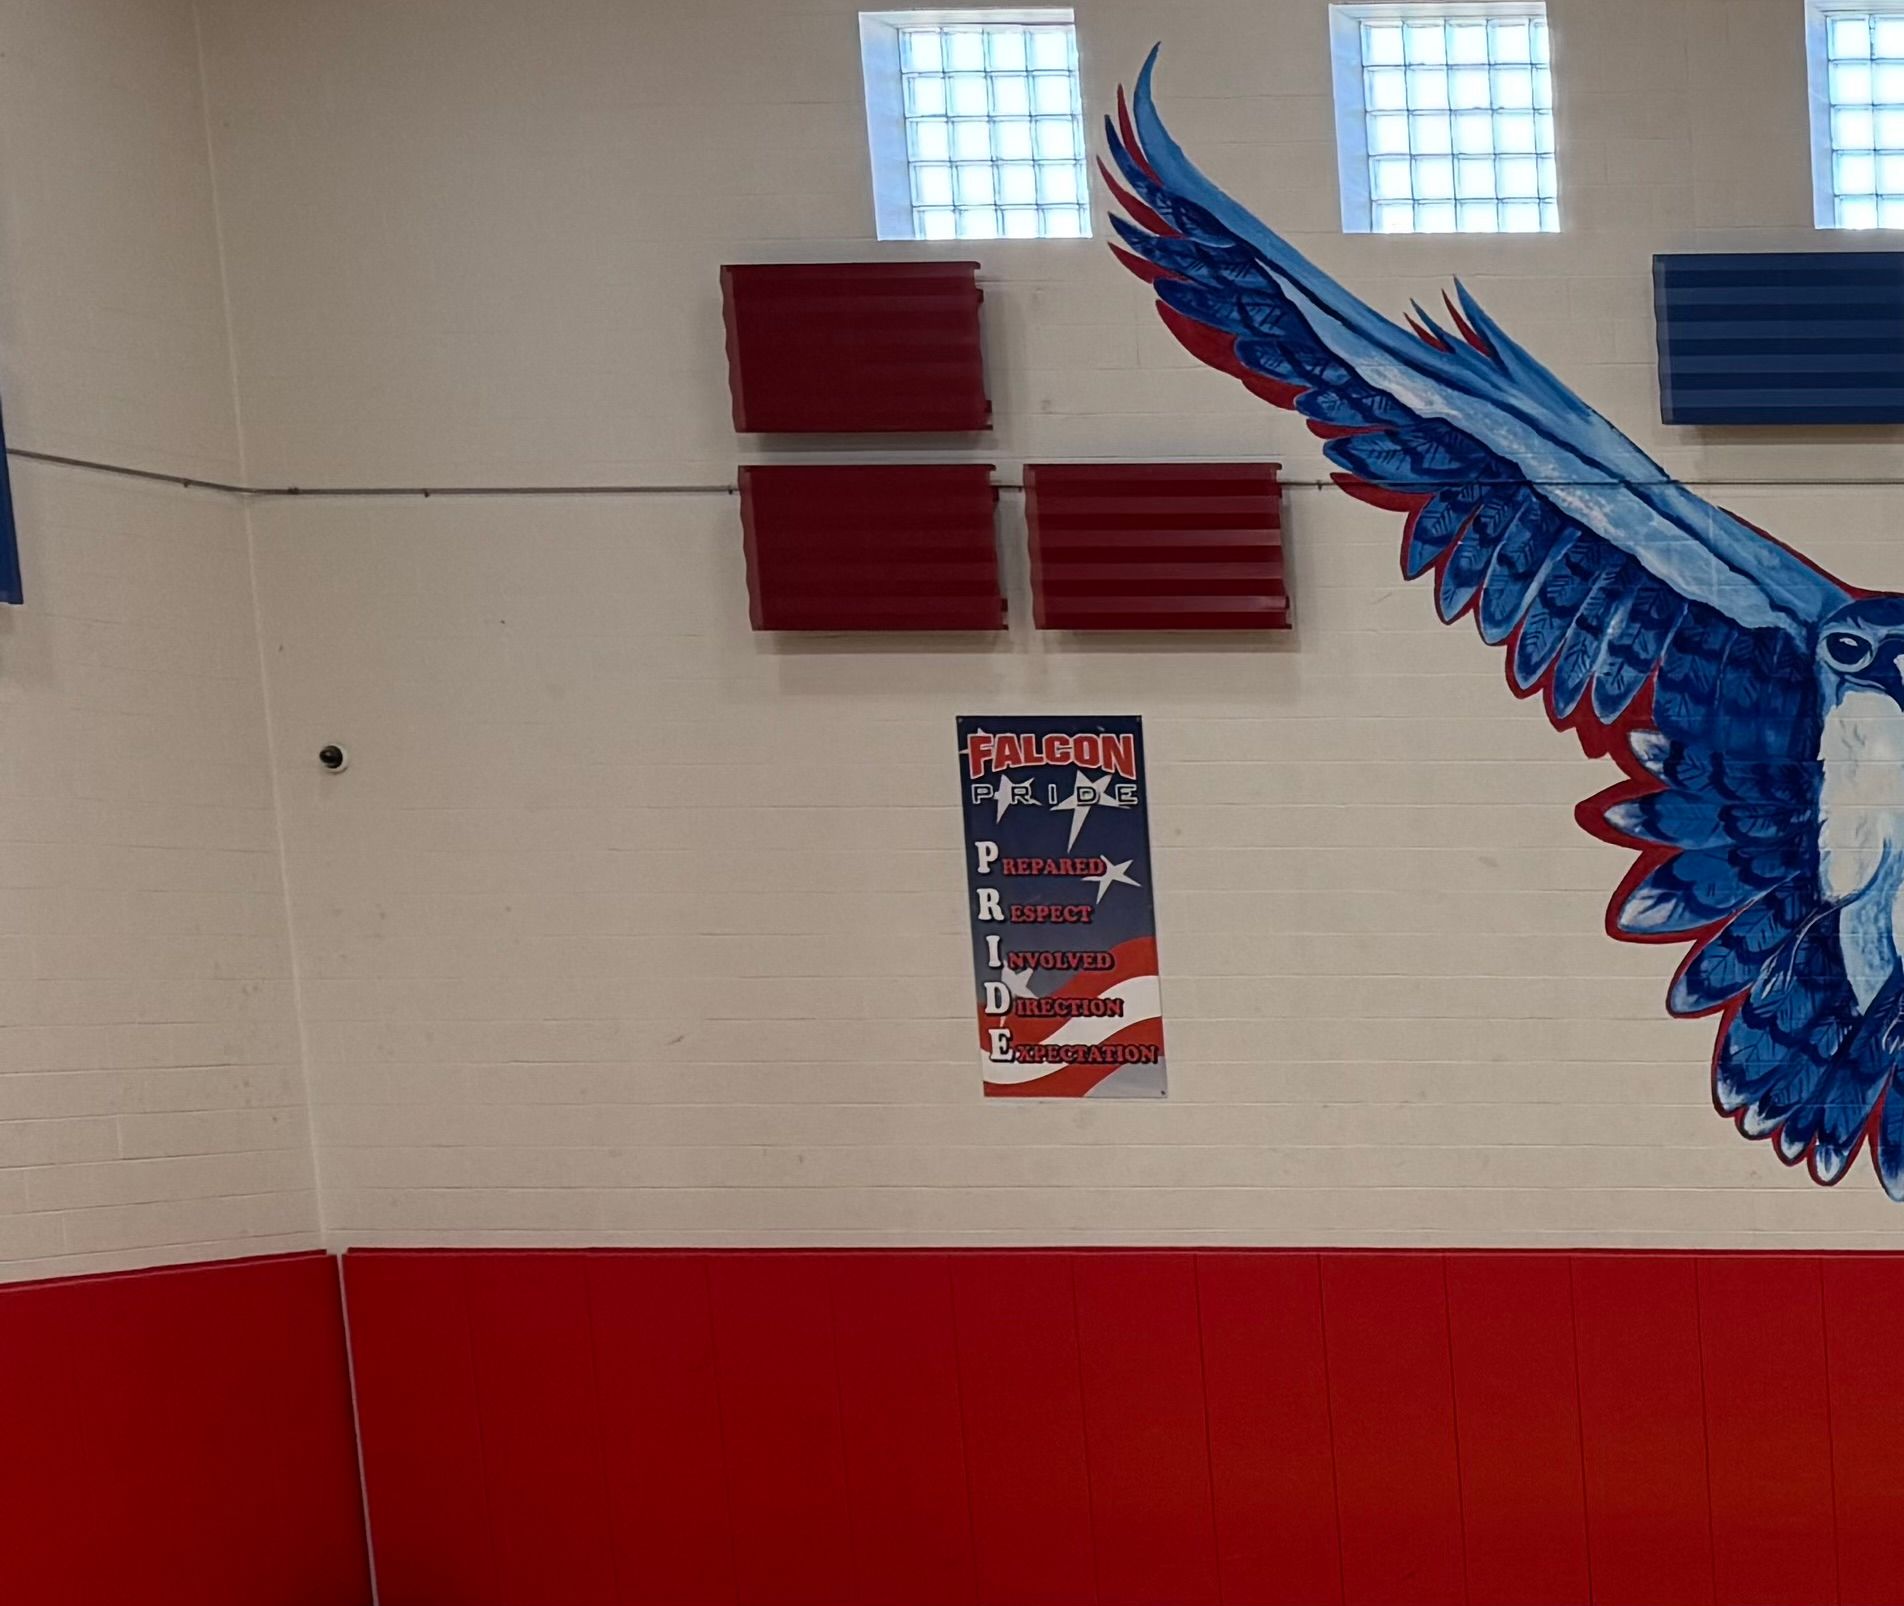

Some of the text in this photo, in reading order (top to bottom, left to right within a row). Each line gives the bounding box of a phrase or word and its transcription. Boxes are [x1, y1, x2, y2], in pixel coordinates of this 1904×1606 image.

[967, 733, 1137, 780] FALCON
[972, 784, 1138, 805] PRIDE
[974, 840, 1105, 875] PREPARED
[976, 888, 1092, 922] RESPECT
[985, 935, 1114, 970] INVOLVED
[983, 981, 1123, 1016] DIRECTION
[988, 1028, 1159, 1063] EXPECTATION
